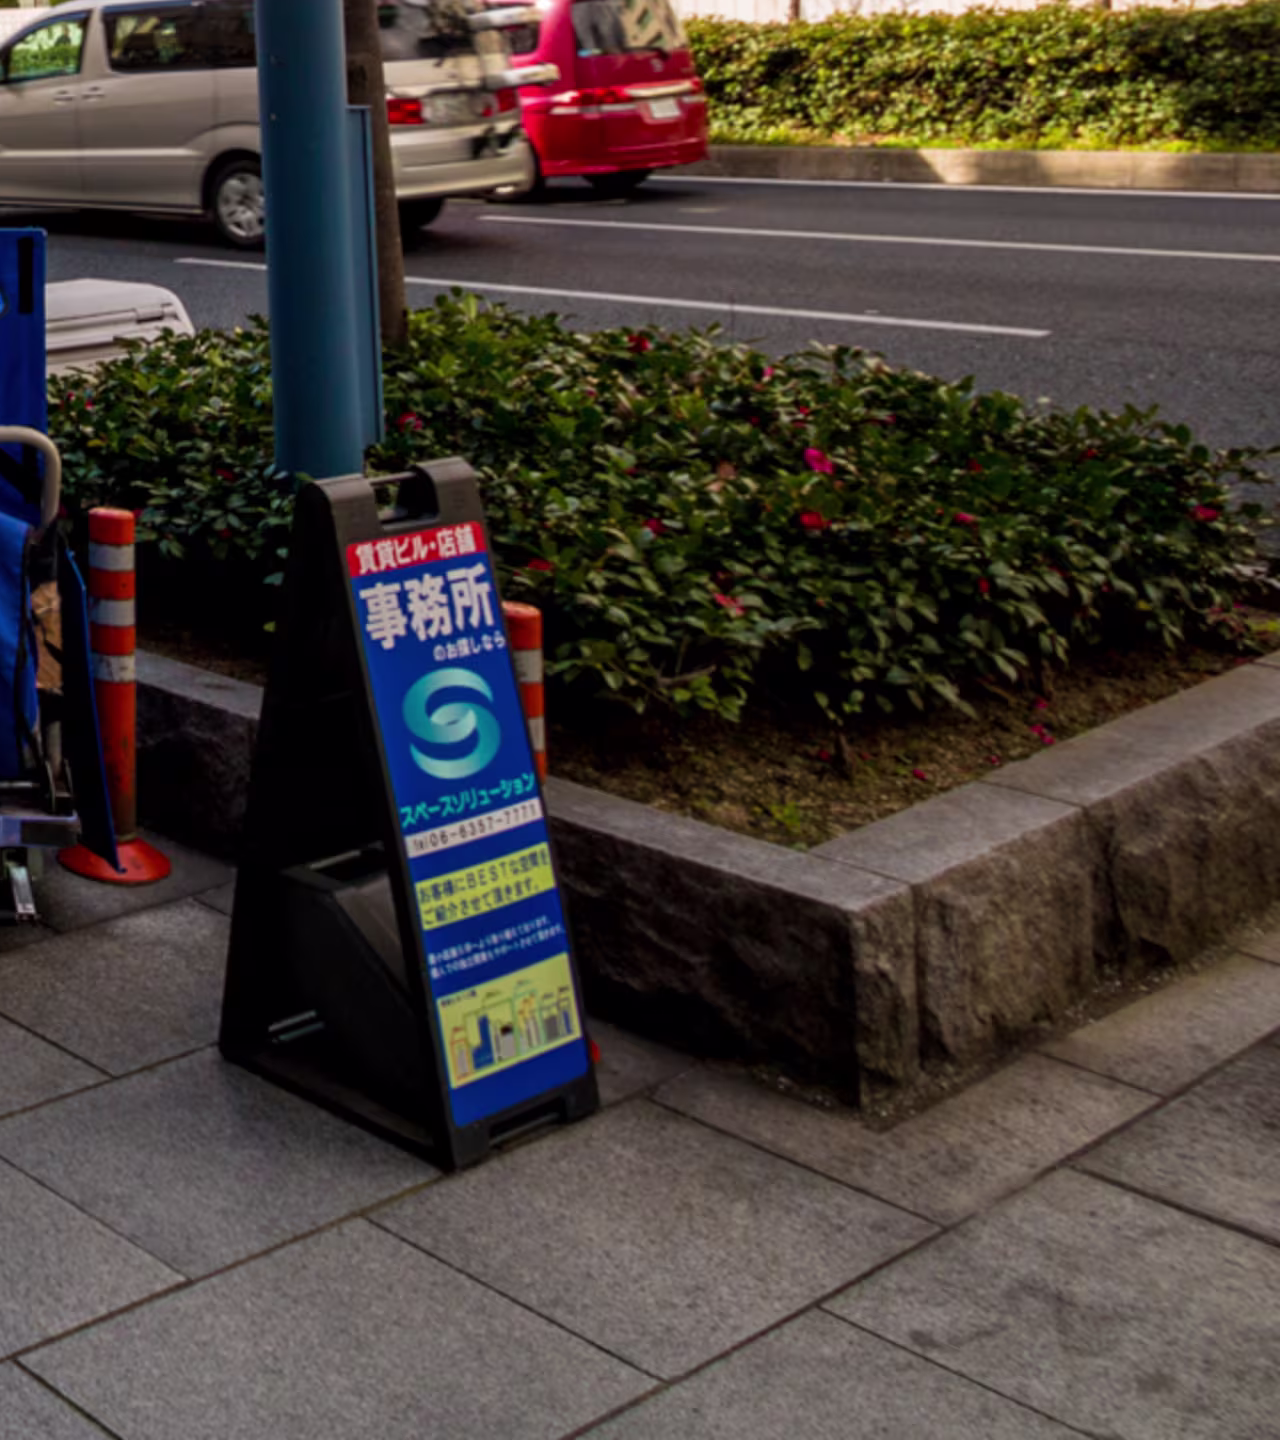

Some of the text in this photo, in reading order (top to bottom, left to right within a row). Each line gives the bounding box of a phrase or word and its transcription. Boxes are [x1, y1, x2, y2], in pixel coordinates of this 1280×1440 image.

[355, 524, 478, 576] 賃貸ビル・店舗
[358, 562, 495, 651] 事務所
[399, 771, 535, 829] スペースソリューション
